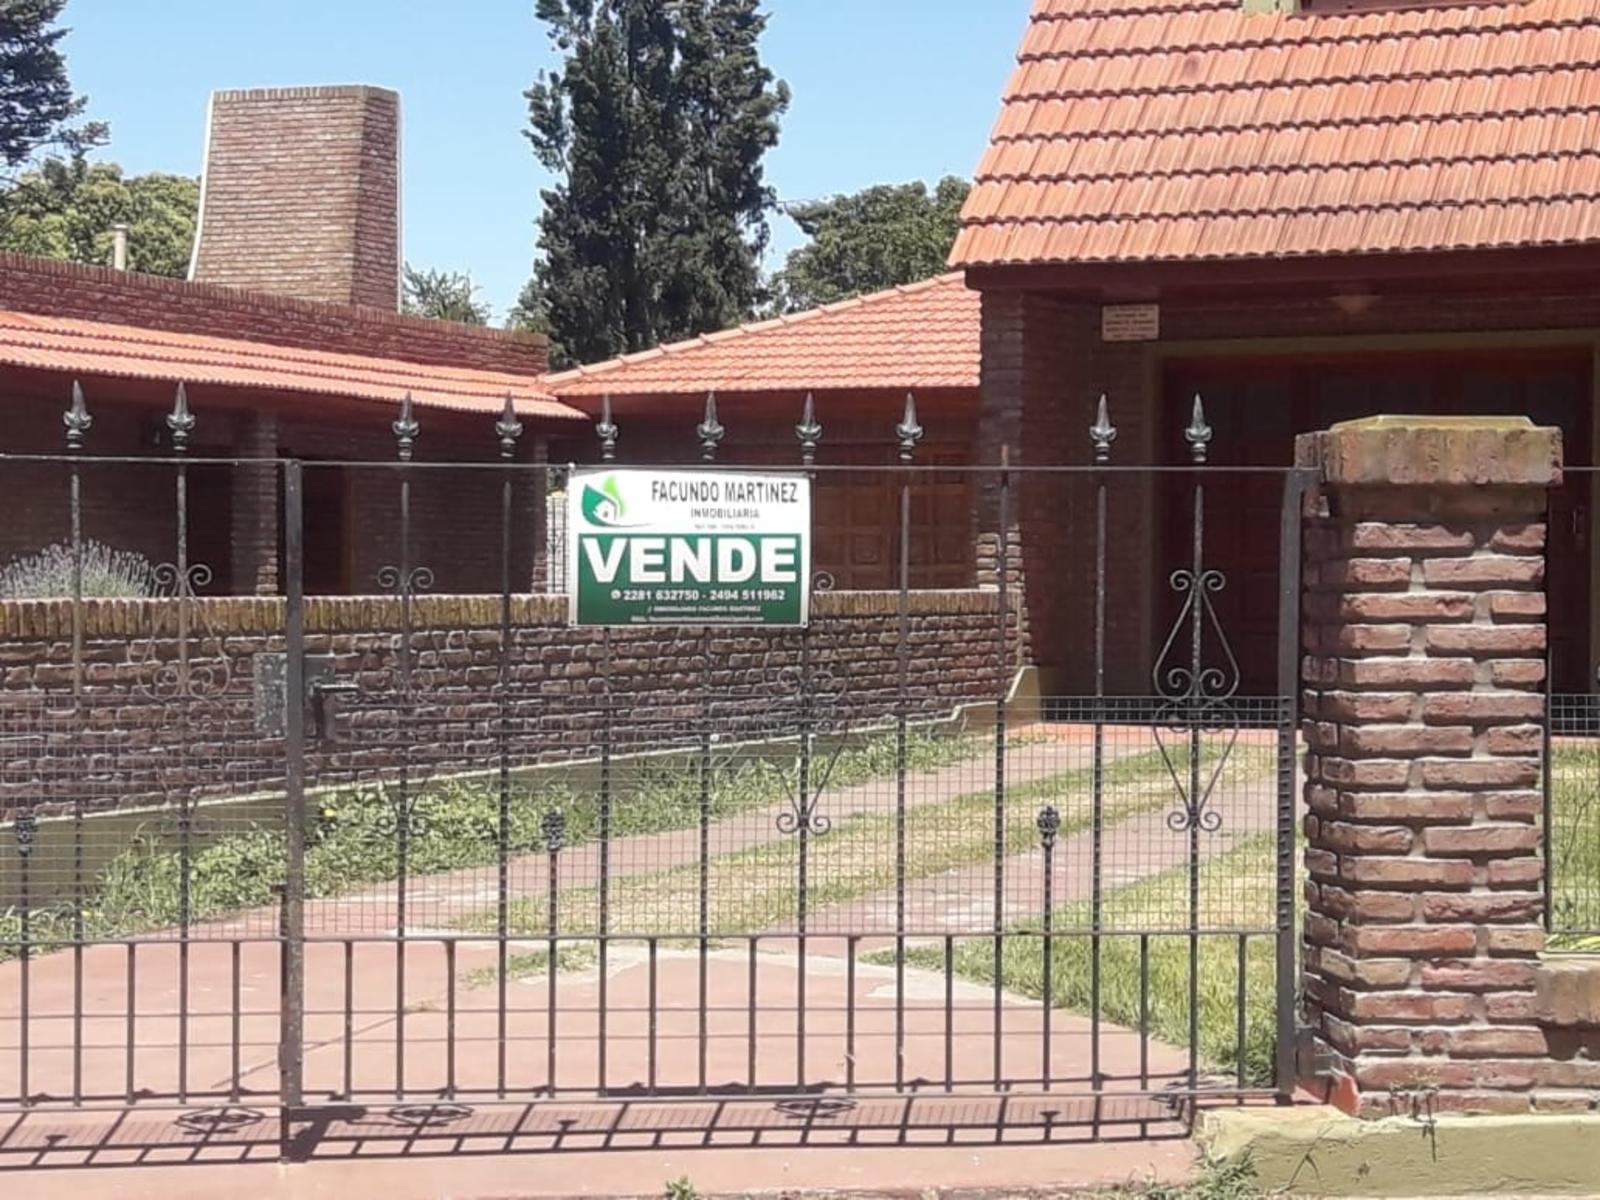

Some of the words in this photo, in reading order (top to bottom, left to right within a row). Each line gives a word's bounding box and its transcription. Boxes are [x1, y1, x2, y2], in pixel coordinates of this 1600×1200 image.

[651, 480, 719, 502] FACUNDO
[724, 482, 798, 503] MARTINEZ
[690, 507, 760, 519] INMOBILIARIA
[582, 537, 797, 583] VENDE
[623, 589, 651, 601] 2281
